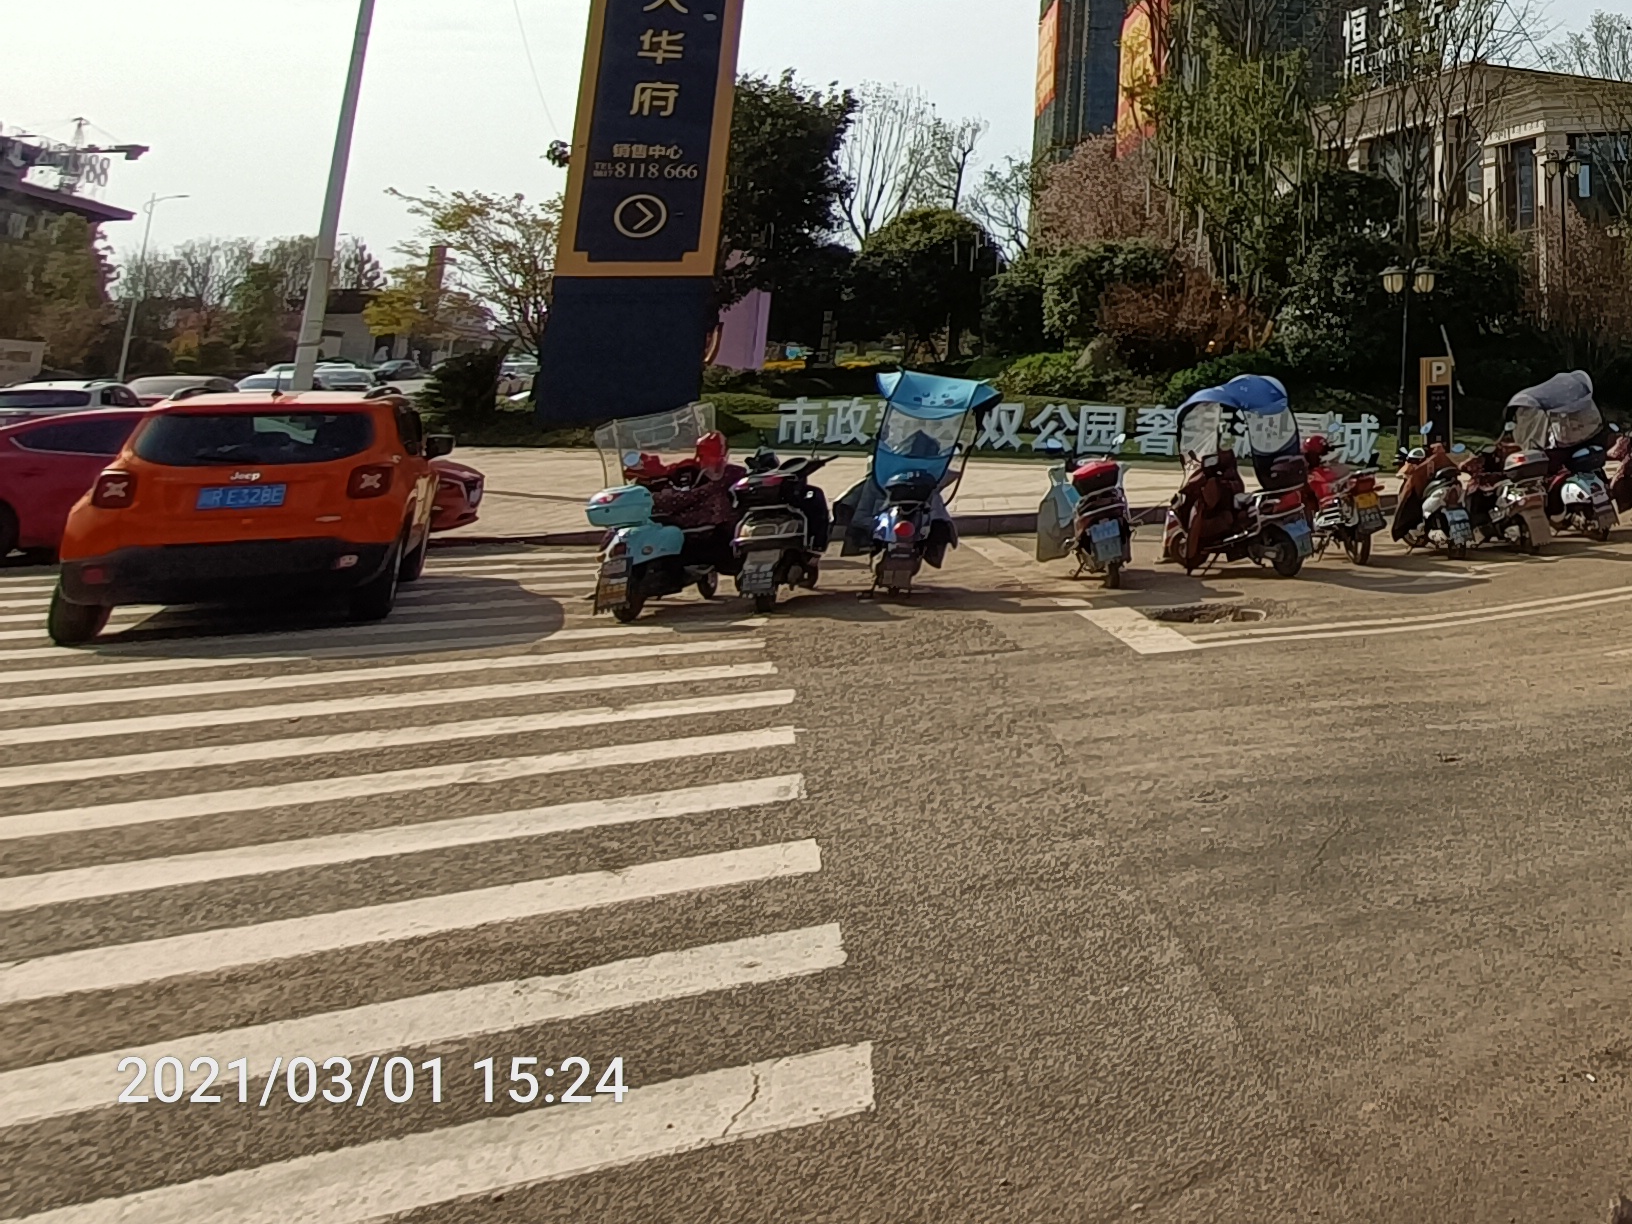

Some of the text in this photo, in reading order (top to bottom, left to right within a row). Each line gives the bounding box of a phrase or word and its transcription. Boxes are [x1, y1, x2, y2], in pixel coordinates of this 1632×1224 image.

[614, 161, 660, 178] 8118
[663, 163, 698, 179] 666
[1431, 361, 1447, 383] P
